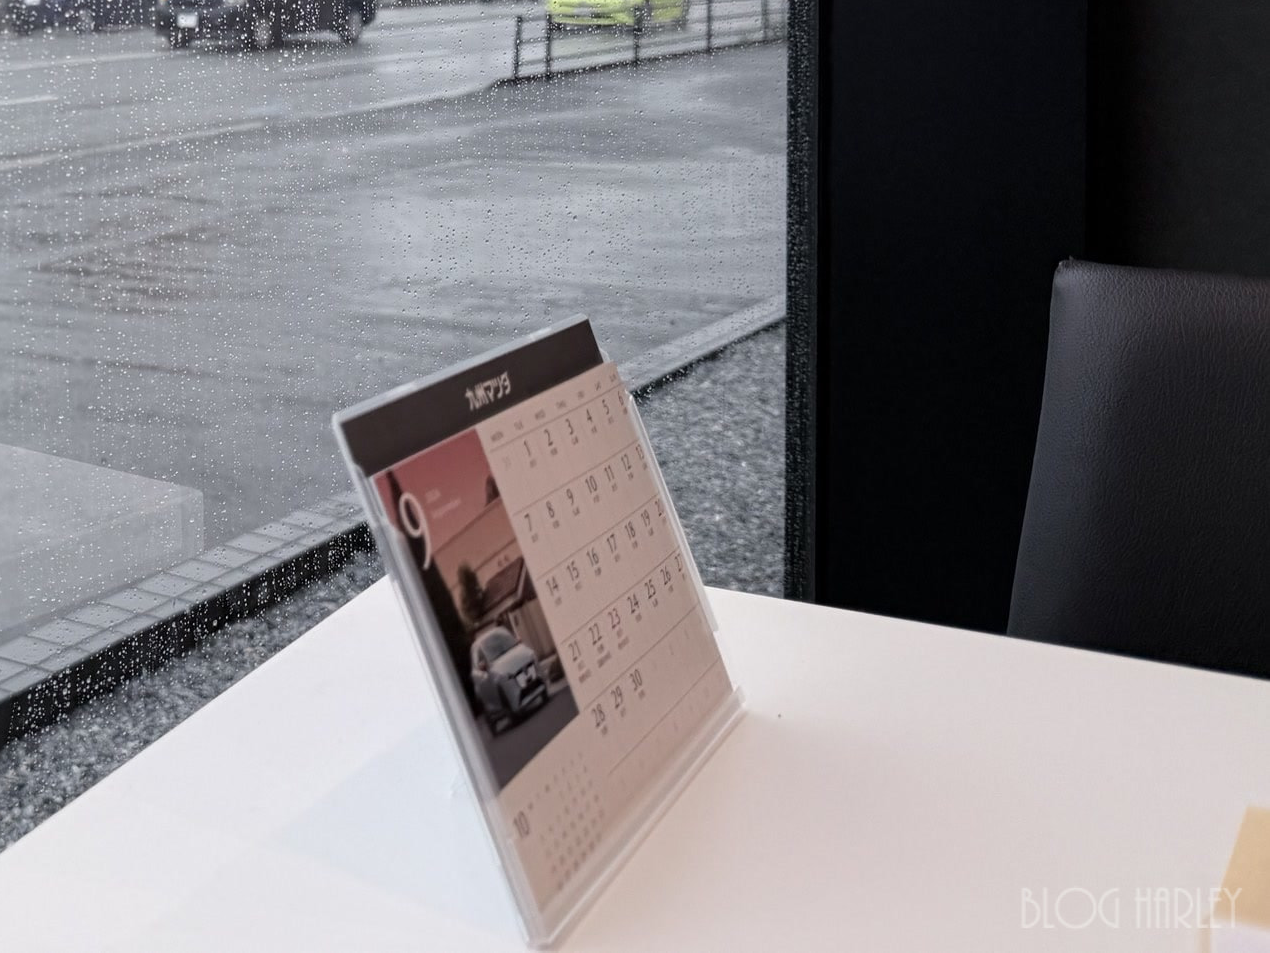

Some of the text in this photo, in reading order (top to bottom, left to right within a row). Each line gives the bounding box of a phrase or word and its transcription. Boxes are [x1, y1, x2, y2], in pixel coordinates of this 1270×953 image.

[465, 371, 511, 411] 九州マツダ
[523, 440, 531, 457] 1
[544, 429, 553, 446] 2
[565, 418, 574, 435] 3
[602, 399, 610, 415] 5
[524, 513, 532, 532] 7
[546, 501, 555, 518] 8
[566, 488, 574, 505] 9
[585, 475, 597, 494] 10
[604, 465, 615, 482] 11
[621, 453, 632, 471] 12
[399, 492, 432, 571] 9
[546, 576, 559, 596] 14
[566, 560, 579, 581] 15
[586, 547, 599, 567] 16
[606, 533, 617, 553] 17
[624, 520, 636, 540] 18
[641, 509, 650, 527] 19
[568, 639, 581, 662] 21
[589, 622, 602, 646] 22
[608, 607, 621, 629] 23
[627, 593, 639, 614] 24
[644, 579, 656, 599] 25
[660, 566, 671, 586] 26
[591, 668, 643, 728] 28 29 30
[513, 810, 530, 838] 10
